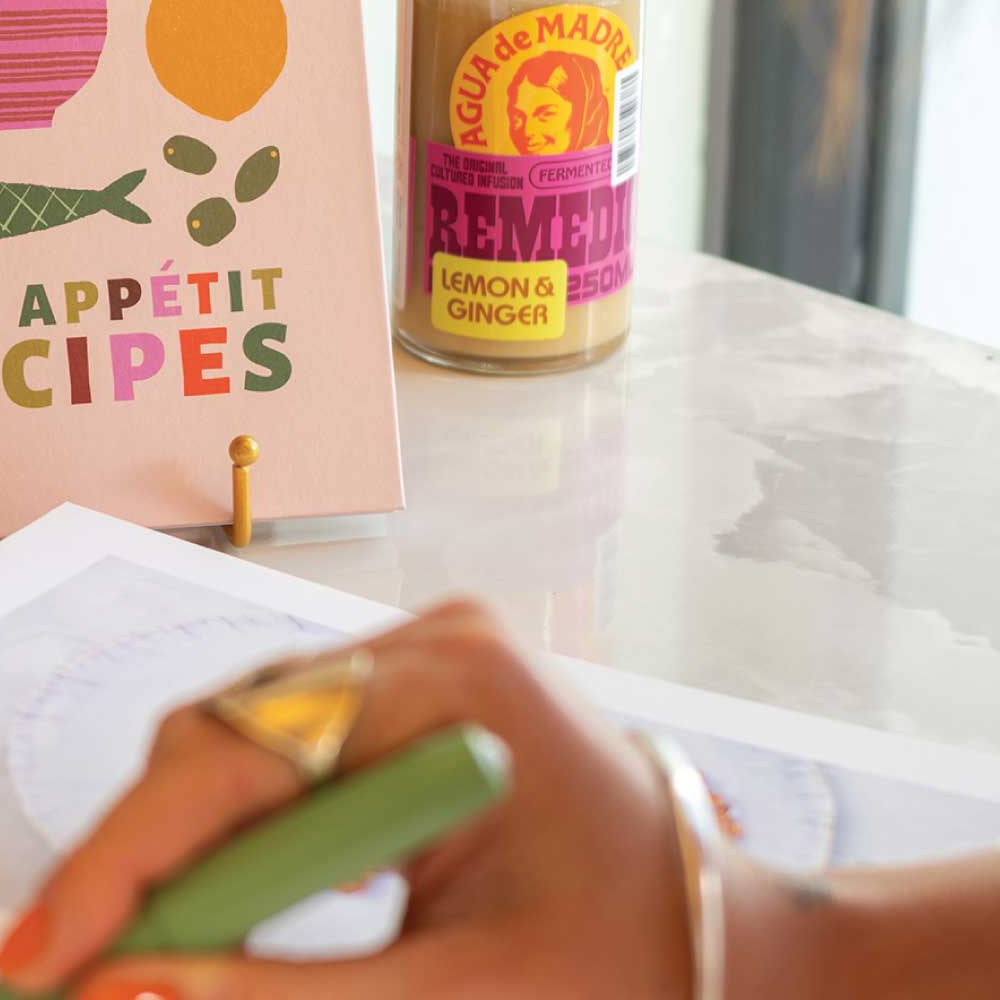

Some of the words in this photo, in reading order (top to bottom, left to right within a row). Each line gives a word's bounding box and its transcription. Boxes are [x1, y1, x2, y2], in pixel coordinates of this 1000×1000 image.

[456, 54, 500, 148] AGUA
[494, 30, 532, 62] de
[536, 13, 632, 71] MADRE
[431, 163, 475, 187] CULTURED
[477, 174, 524, 191] INFUSION
[442, 153, 460, 169] THE
[463, 157, 508, 175] ORIGINAL
[18, 259, 284, 328] APPÉTIT
[441, 268, 530, 298] LEMON
[535, 276, 555, 297] &
[447, 298, 548, 325] GINGER
